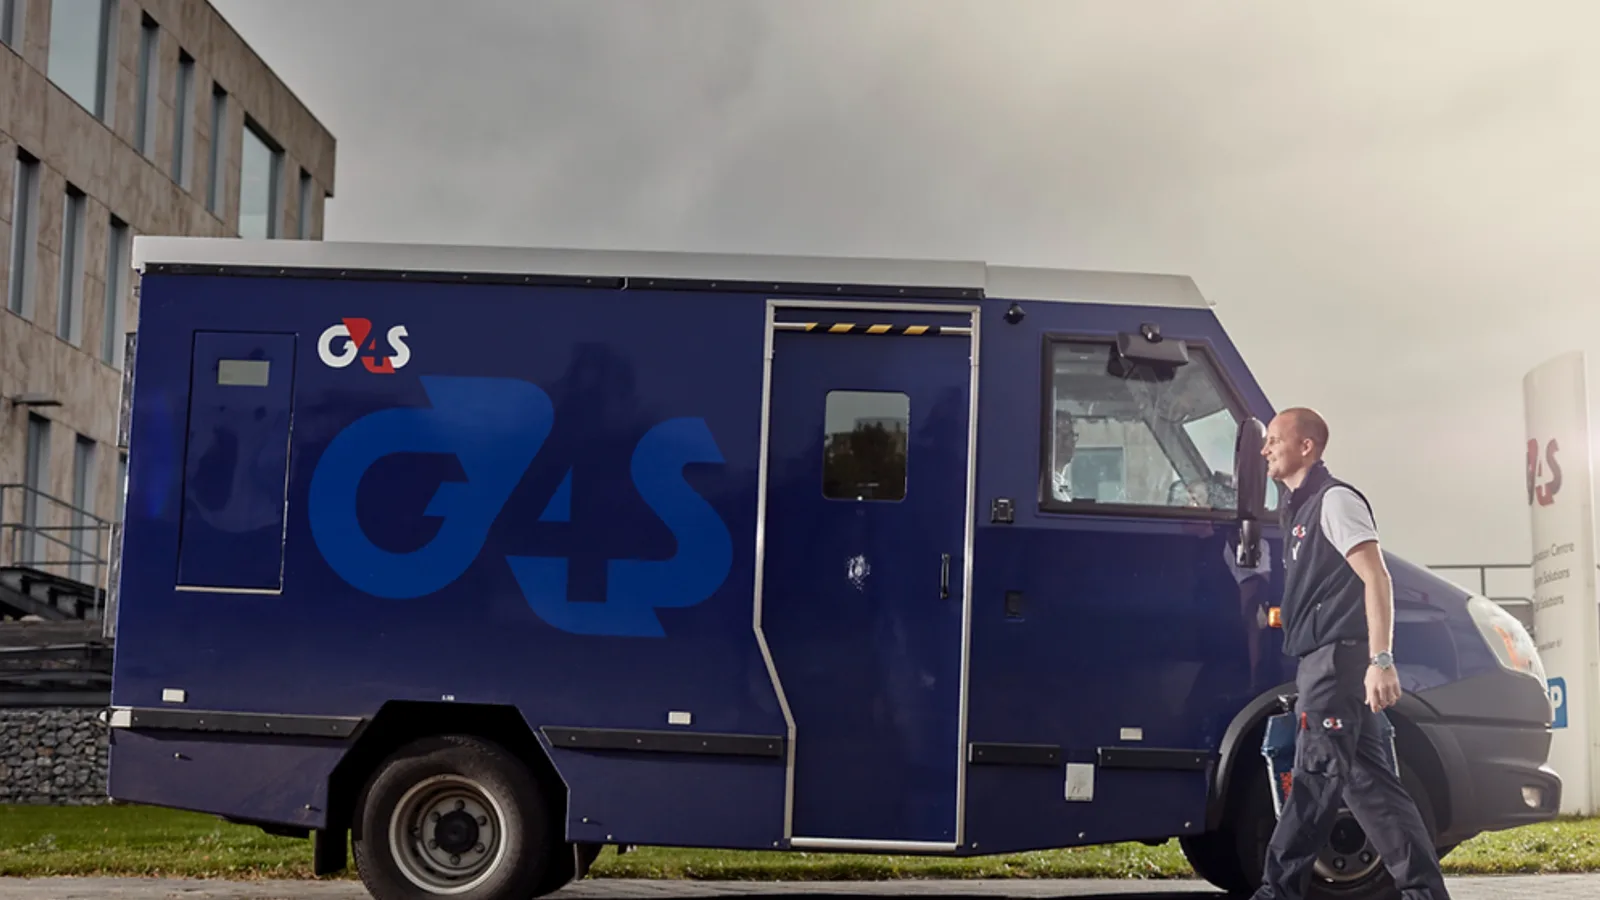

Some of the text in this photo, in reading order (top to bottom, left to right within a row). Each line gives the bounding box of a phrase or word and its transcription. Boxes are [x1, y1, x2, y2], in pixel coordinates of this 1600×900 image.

[317, 317, 411, 374] G4S
[308, 375, 734, 638] G4S
[1549, 685, 1564, 722] P
